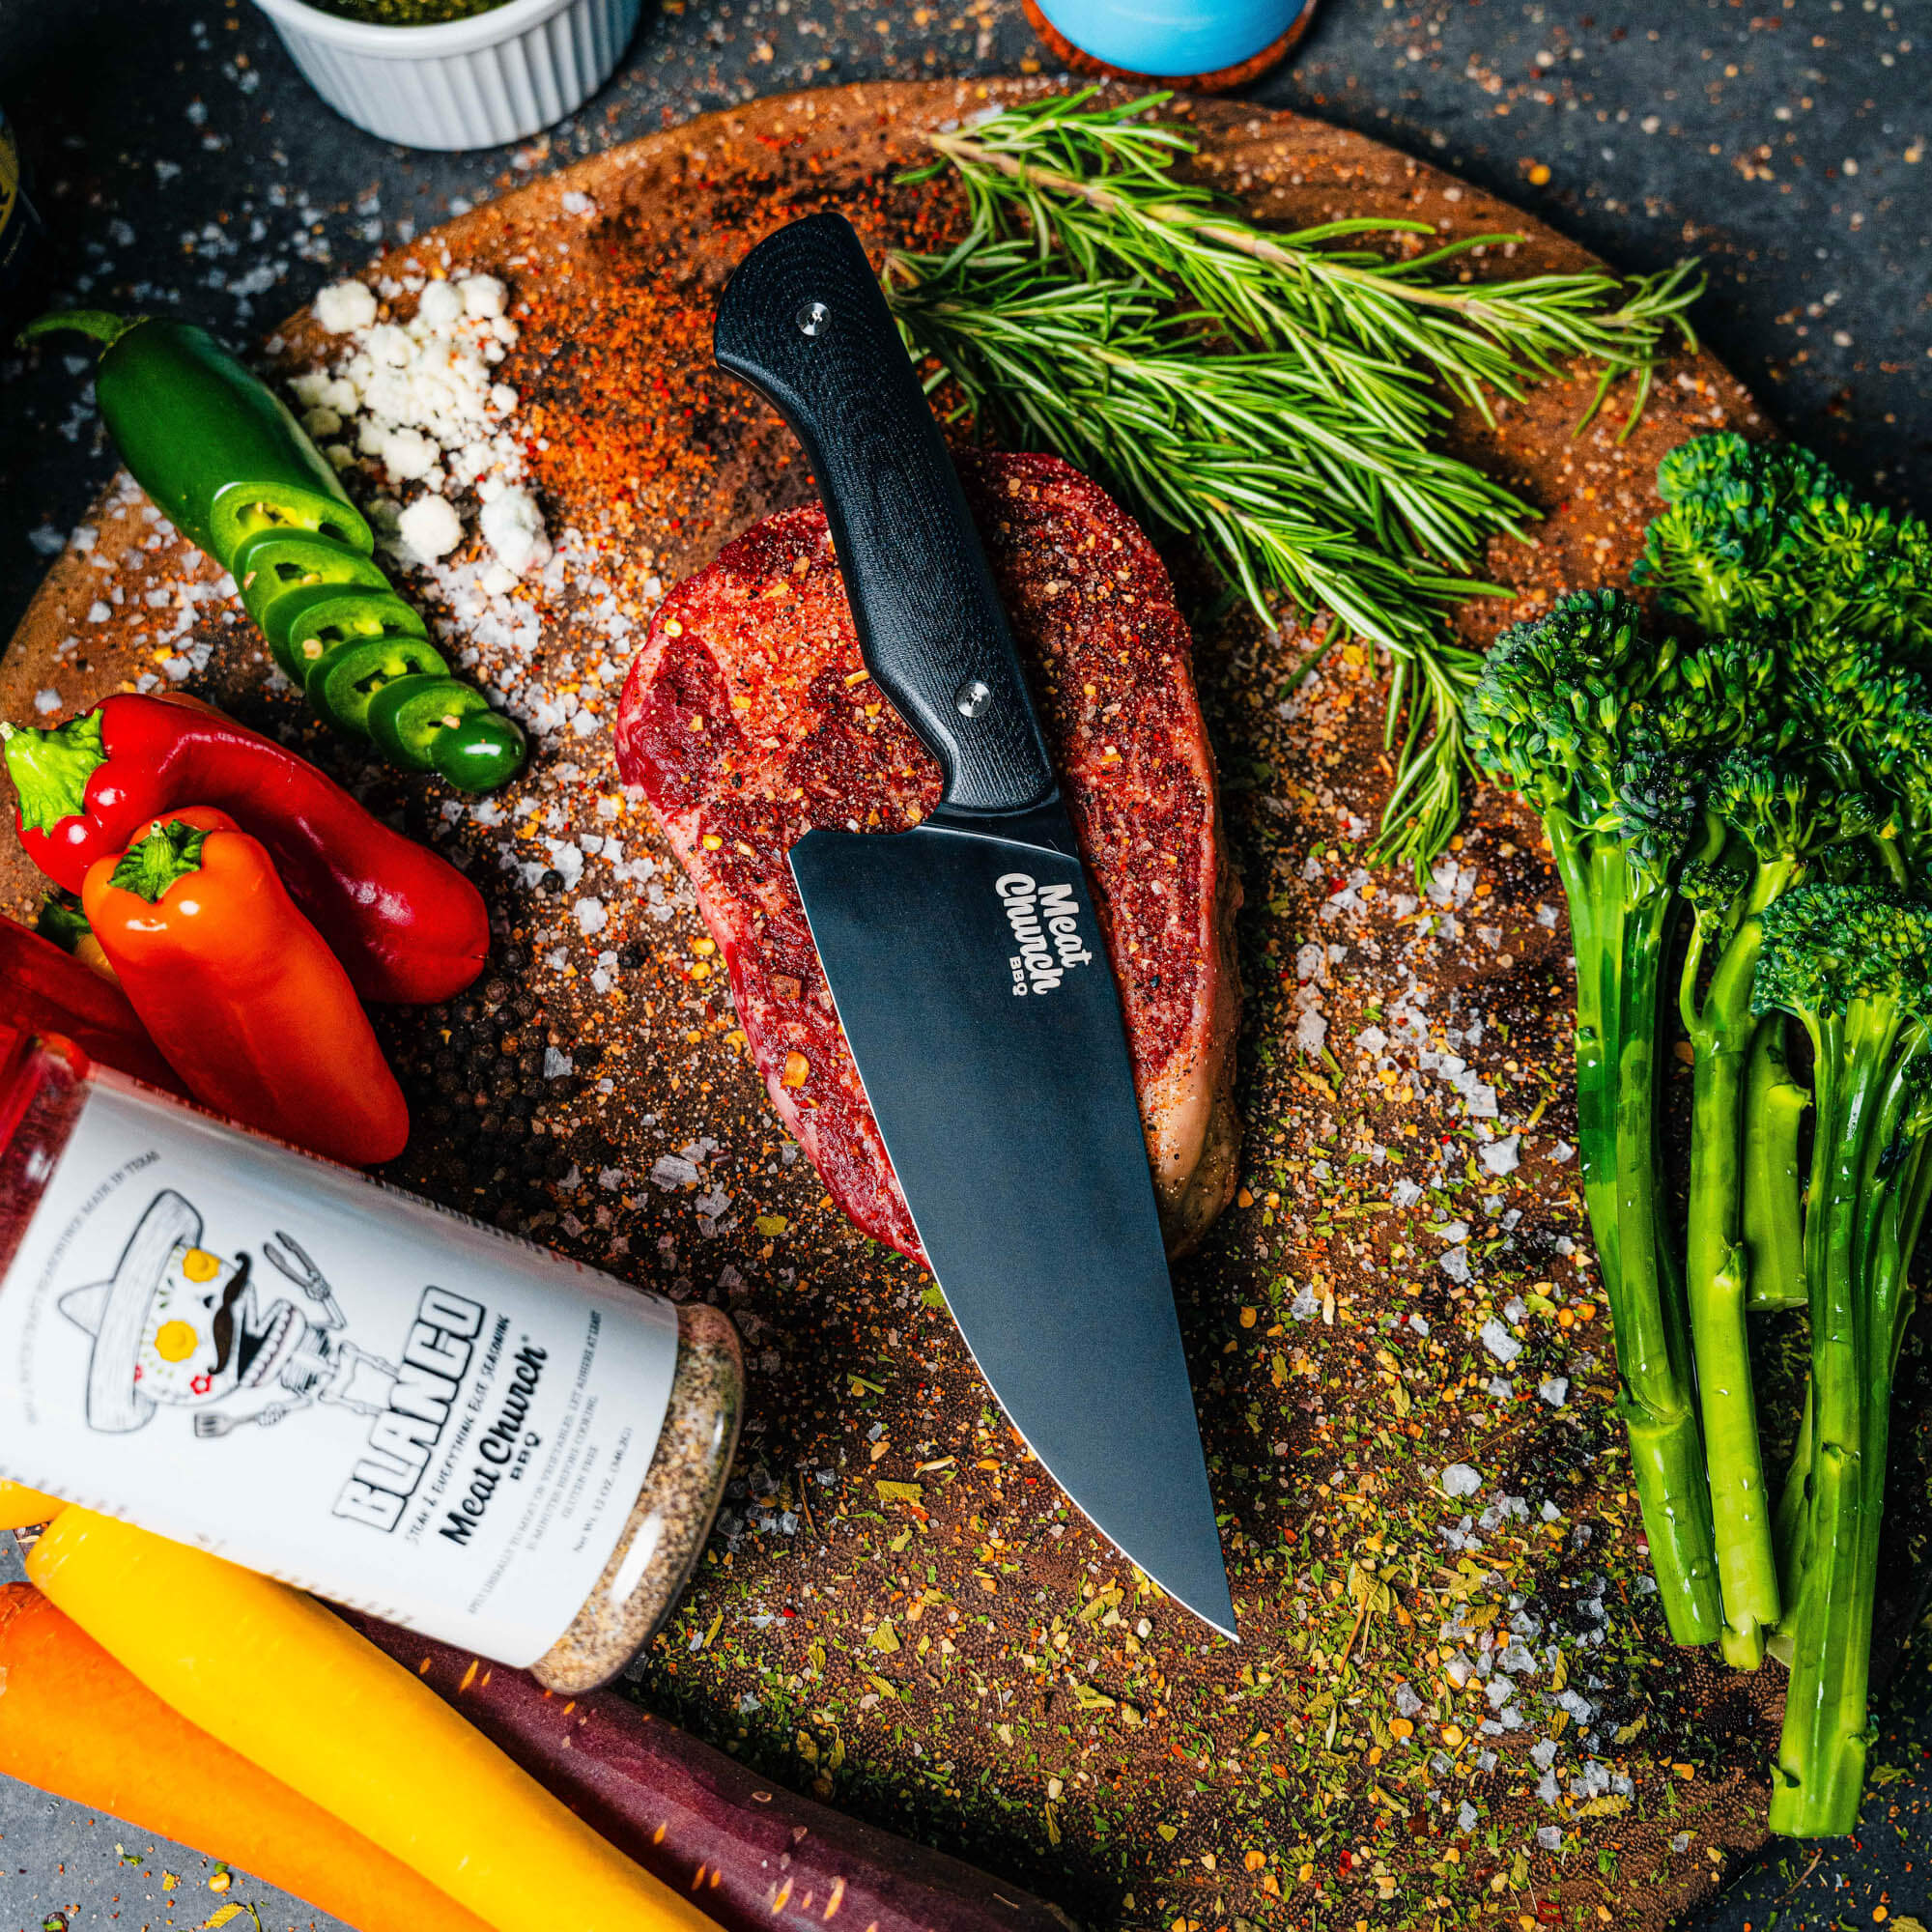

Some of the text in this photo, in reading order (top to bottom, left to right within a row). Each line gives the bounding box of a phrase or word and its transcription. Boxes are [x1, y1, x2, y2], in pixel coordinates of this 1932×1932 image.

[995, 873, 1064, 995] Church
[1037, 884, 1093, 968] Meat
[1009, 956, 1028, 996] BBQ
[468, 1381, 489, 1412] ELSE
[481, 1313, 510, 1381] SEASONING
[331, 1285, 487, 1533] BLANCO
[510, 1432, 542, 1480] BBQ
[439, 1465, 501, 1546] Meat
